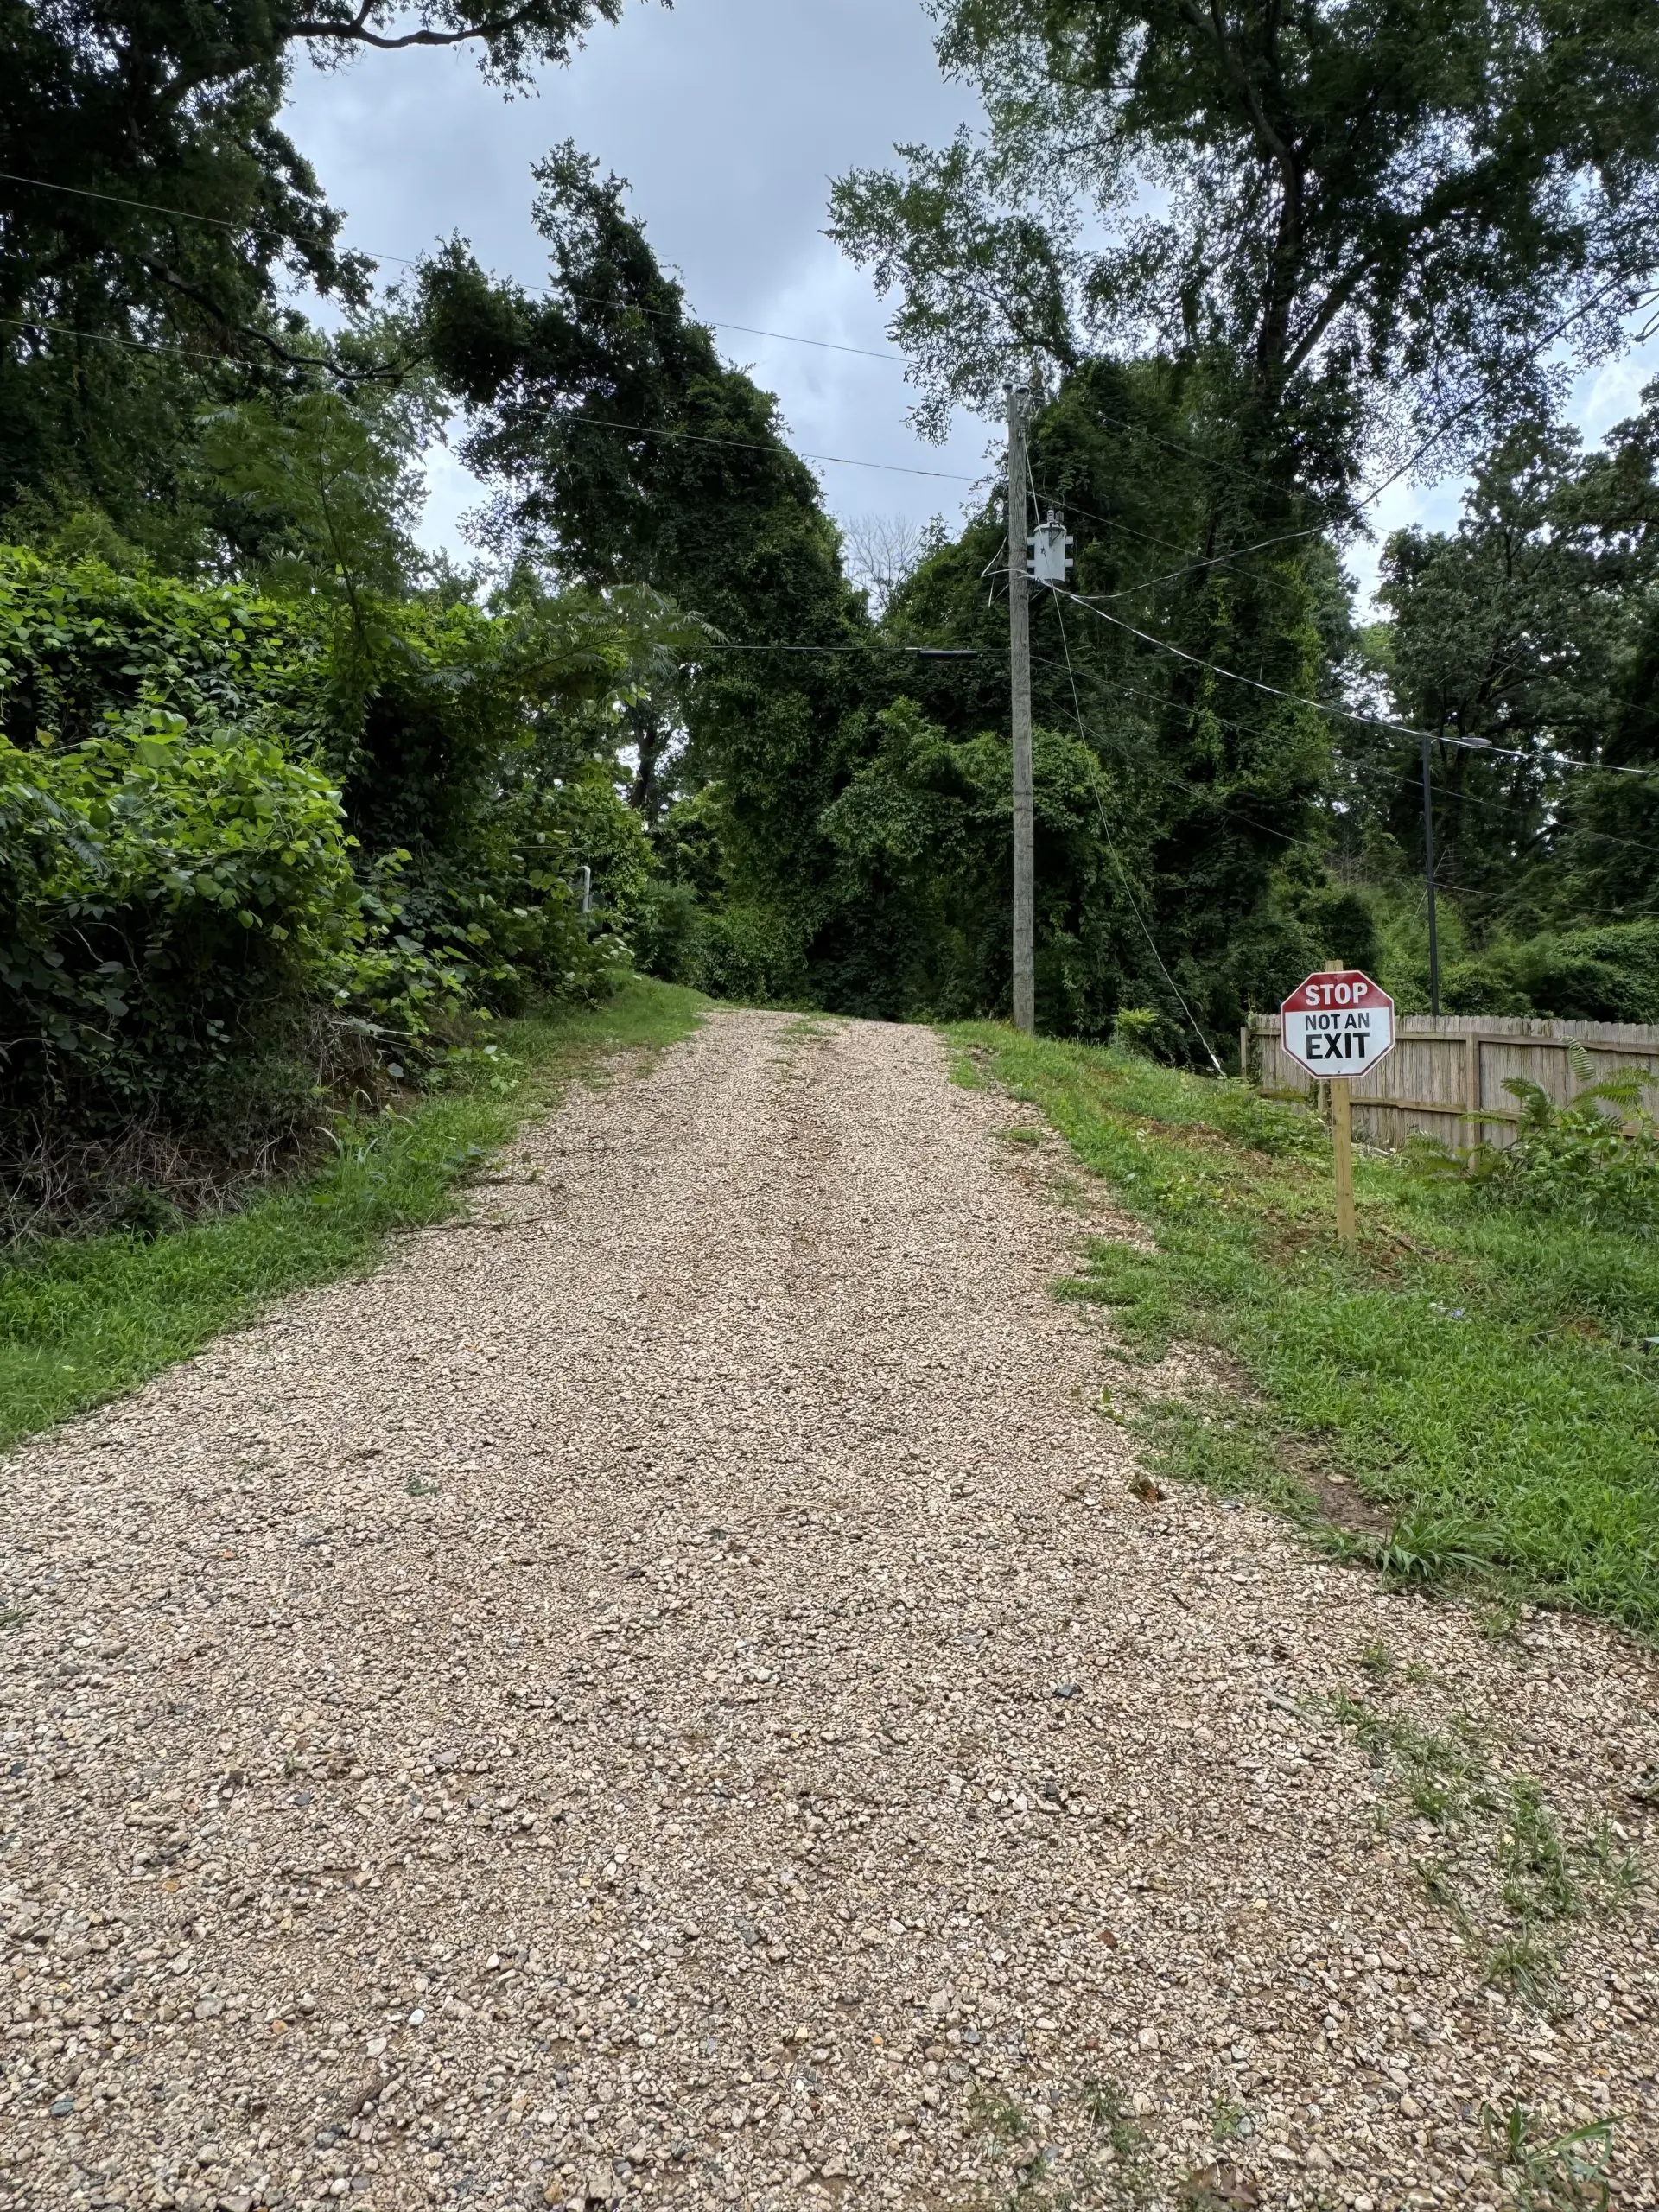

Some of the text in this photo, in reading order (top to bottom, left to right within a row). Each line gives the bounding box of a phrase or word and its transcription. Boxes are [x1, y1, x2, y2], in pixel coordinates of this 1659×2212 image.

[1305, 982, 1368, 1006] STOP
[1305, 1012, 1370, 1031] NOT AN
[1306, 1032, 1370, 1059] EXIT
